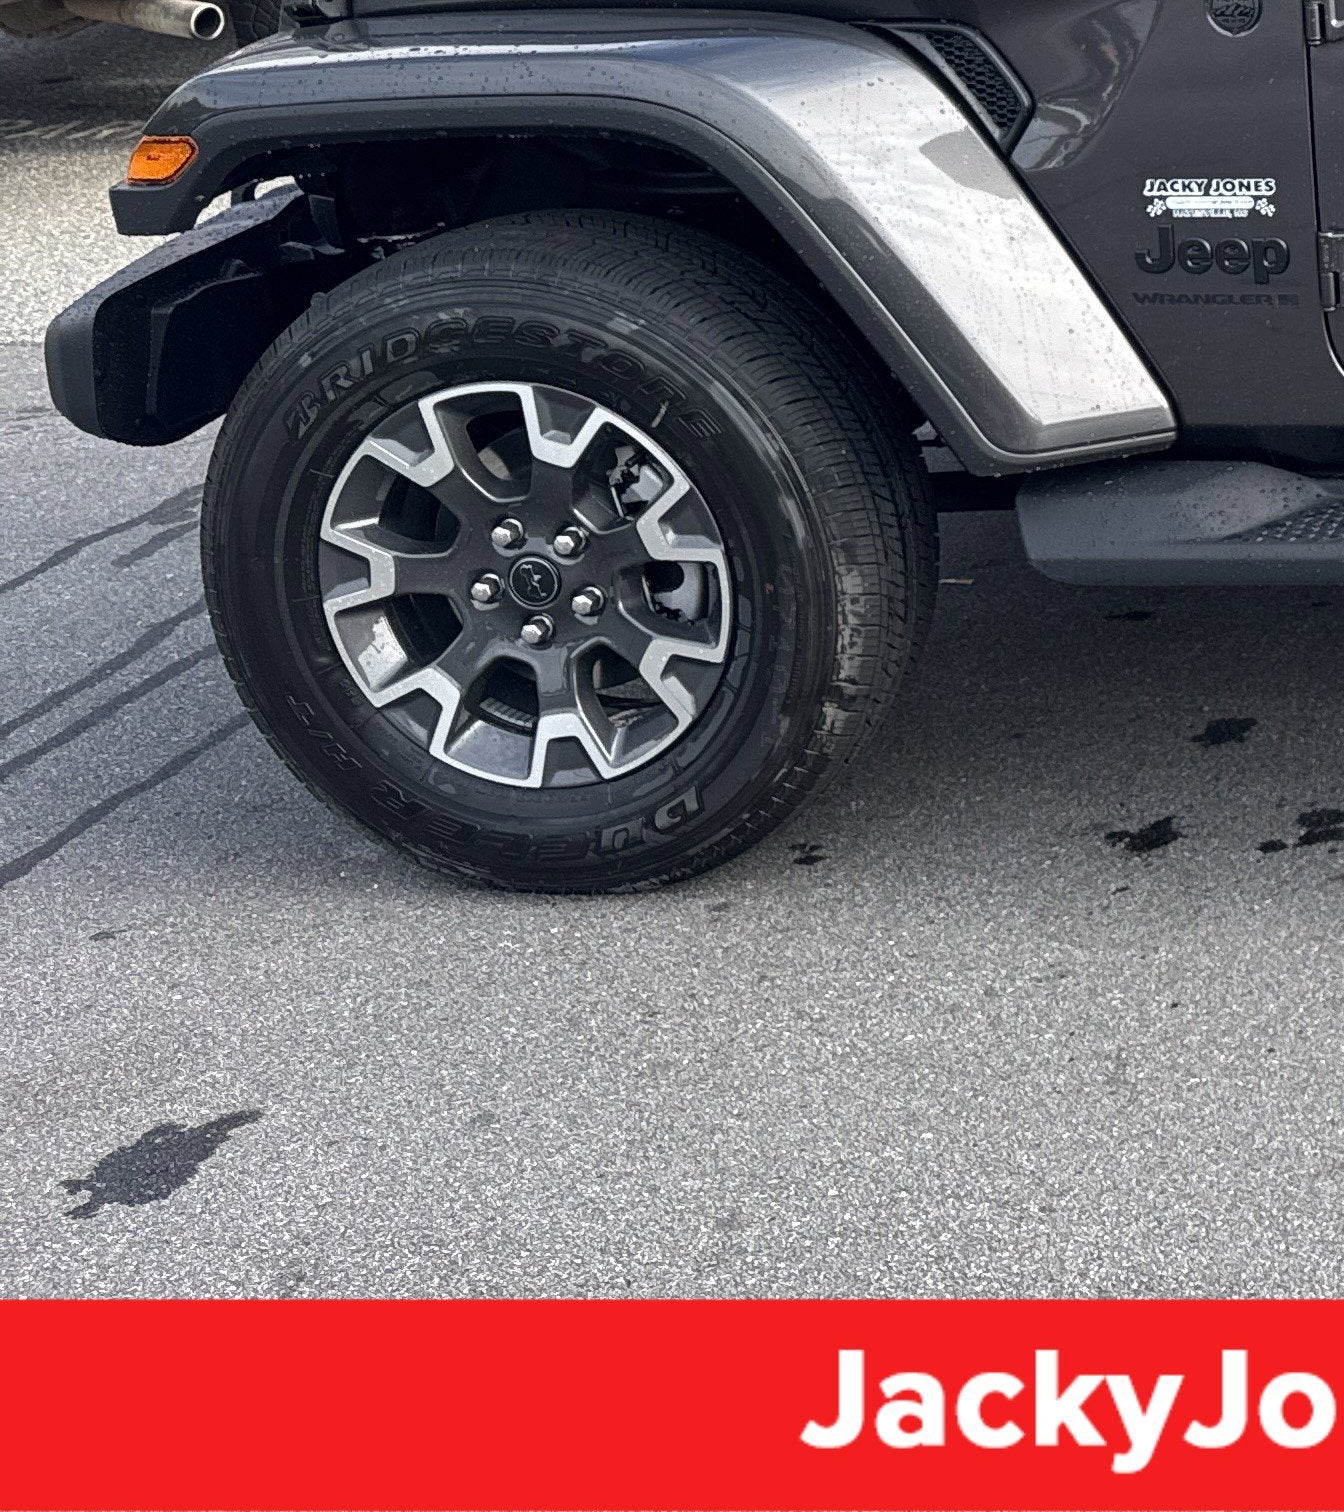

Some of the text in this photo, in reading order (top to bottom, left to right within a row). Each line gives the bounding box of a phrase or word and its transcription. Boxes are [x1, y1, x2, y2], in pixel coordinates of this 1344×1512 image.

[1144, 179, 1275, 194] JACKY JONES
[1134, 223, 1290, 284] Jeep
[1131, 292, 1275, 306] WRANGLER
